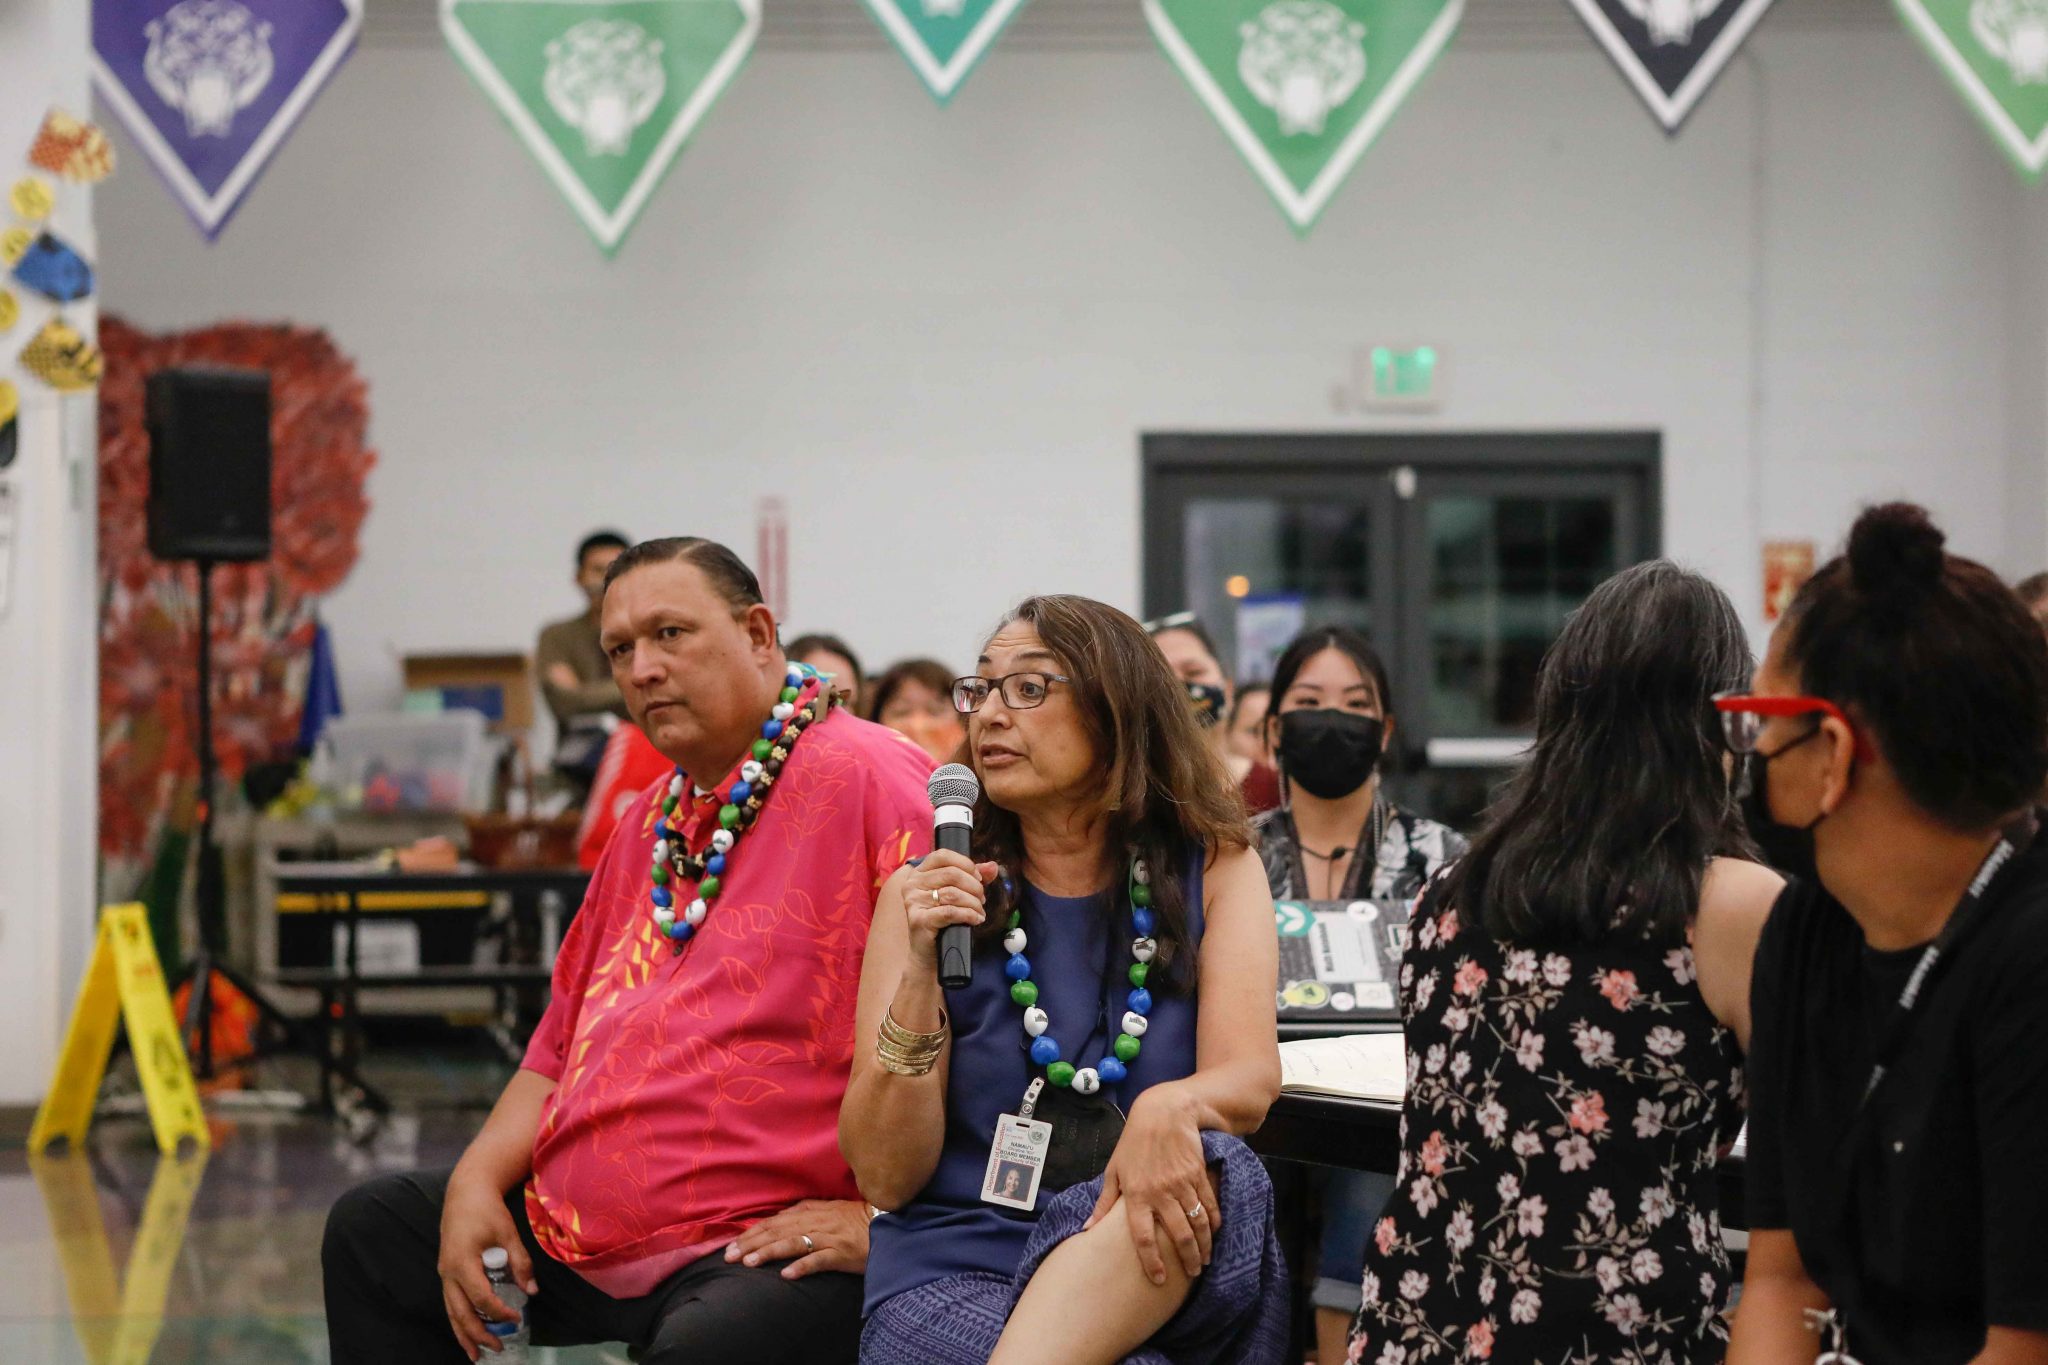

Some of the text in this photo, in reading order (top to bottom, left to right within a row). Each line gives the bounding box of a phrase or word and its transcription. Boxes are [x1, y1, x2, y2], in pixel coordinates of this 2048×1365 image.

[964, 811, 970, 822] 1
[987, 1158, 998, 1191] Department
[996, 1123, 1006, 1151] Education
[1000, 1150, 1018, 1158] BOARD
[1018, 1154, 1041, 1162] MEMBER
